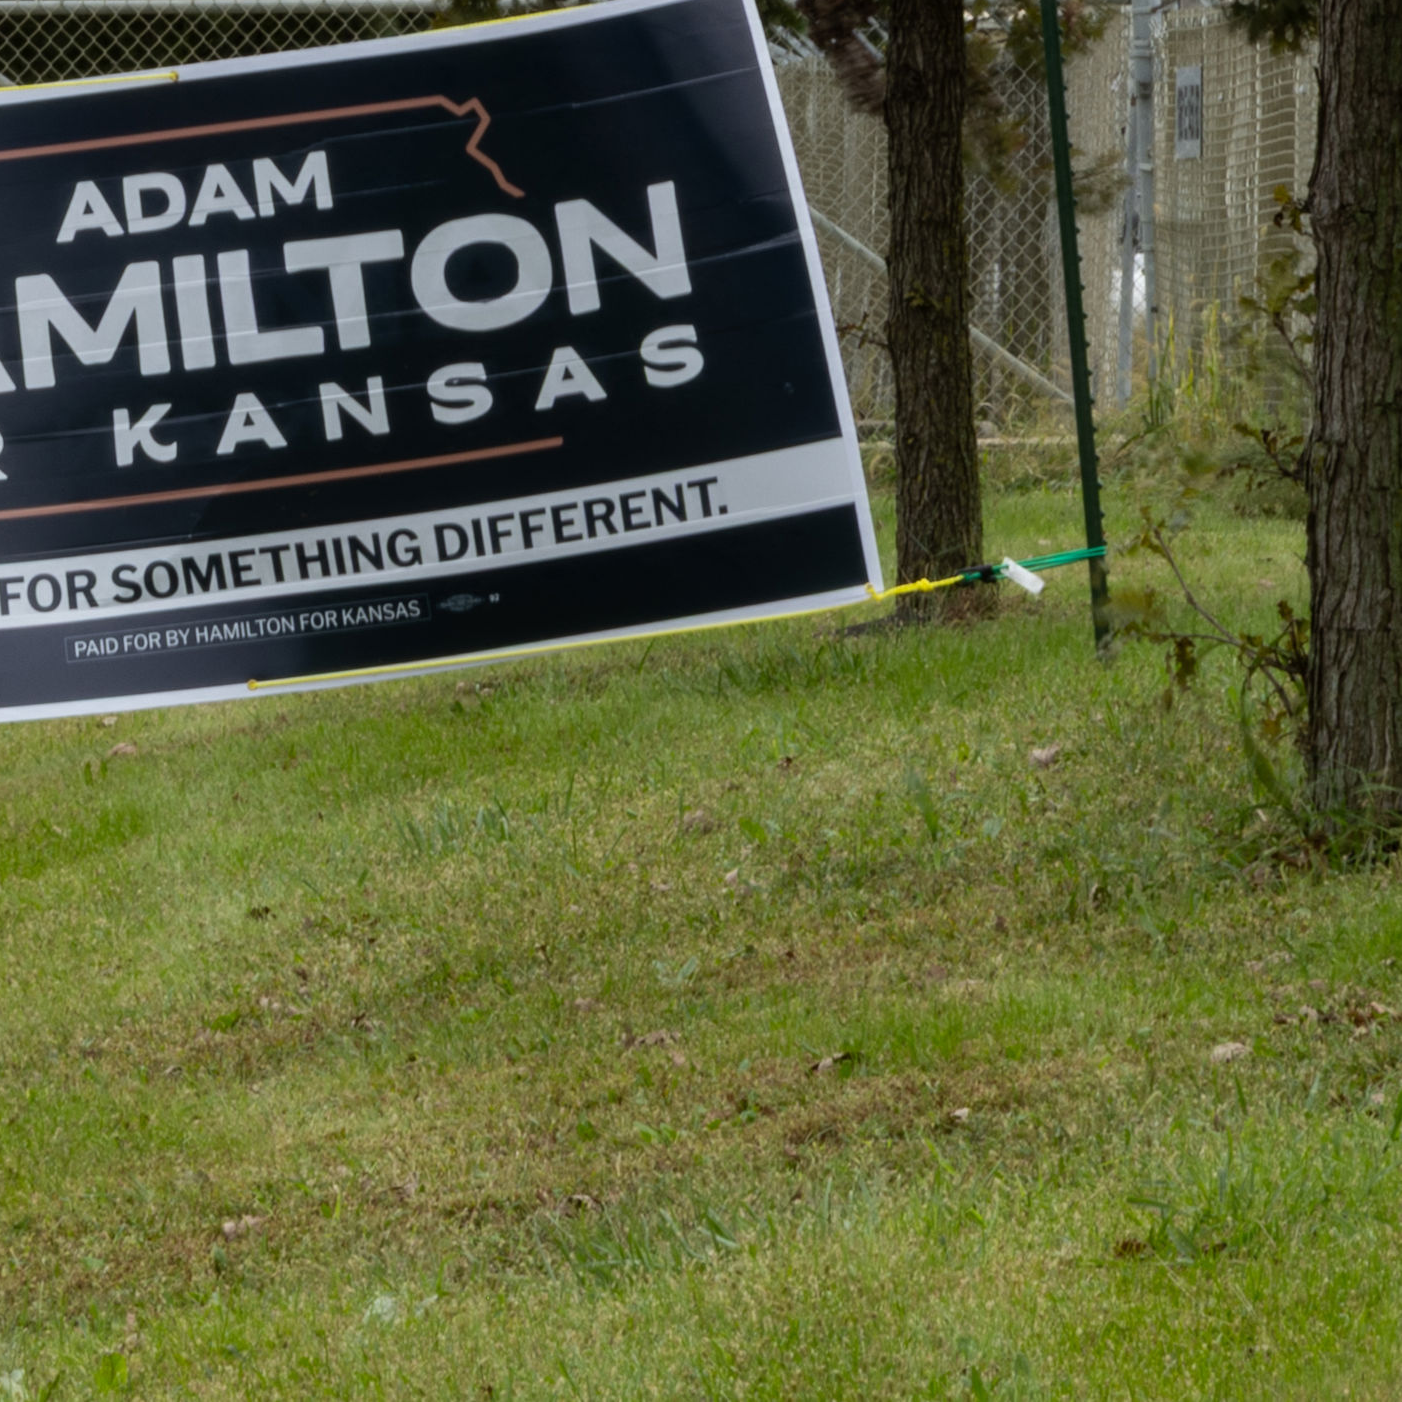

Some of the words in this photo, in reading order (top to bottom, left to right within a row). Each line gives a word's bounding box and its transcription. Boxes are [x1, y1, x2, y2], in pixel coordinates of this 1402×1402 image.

[56, 150, 334, 243] ADAM
[113, 324, 705, 467] KANSAS
[109, 526, 424, 605] SOMETHING
[435, 476, 730, 565] DIFFERENT.
[73, 638, 119, 658] PAID
[123, 632, 162, 652] FOR
[165, 628, 191, 648] BY
[195, 615, 296, 644] HAMILTON
[299, 610, 338, 632] FOR
[341, 599, 421, 625] KANSAS
